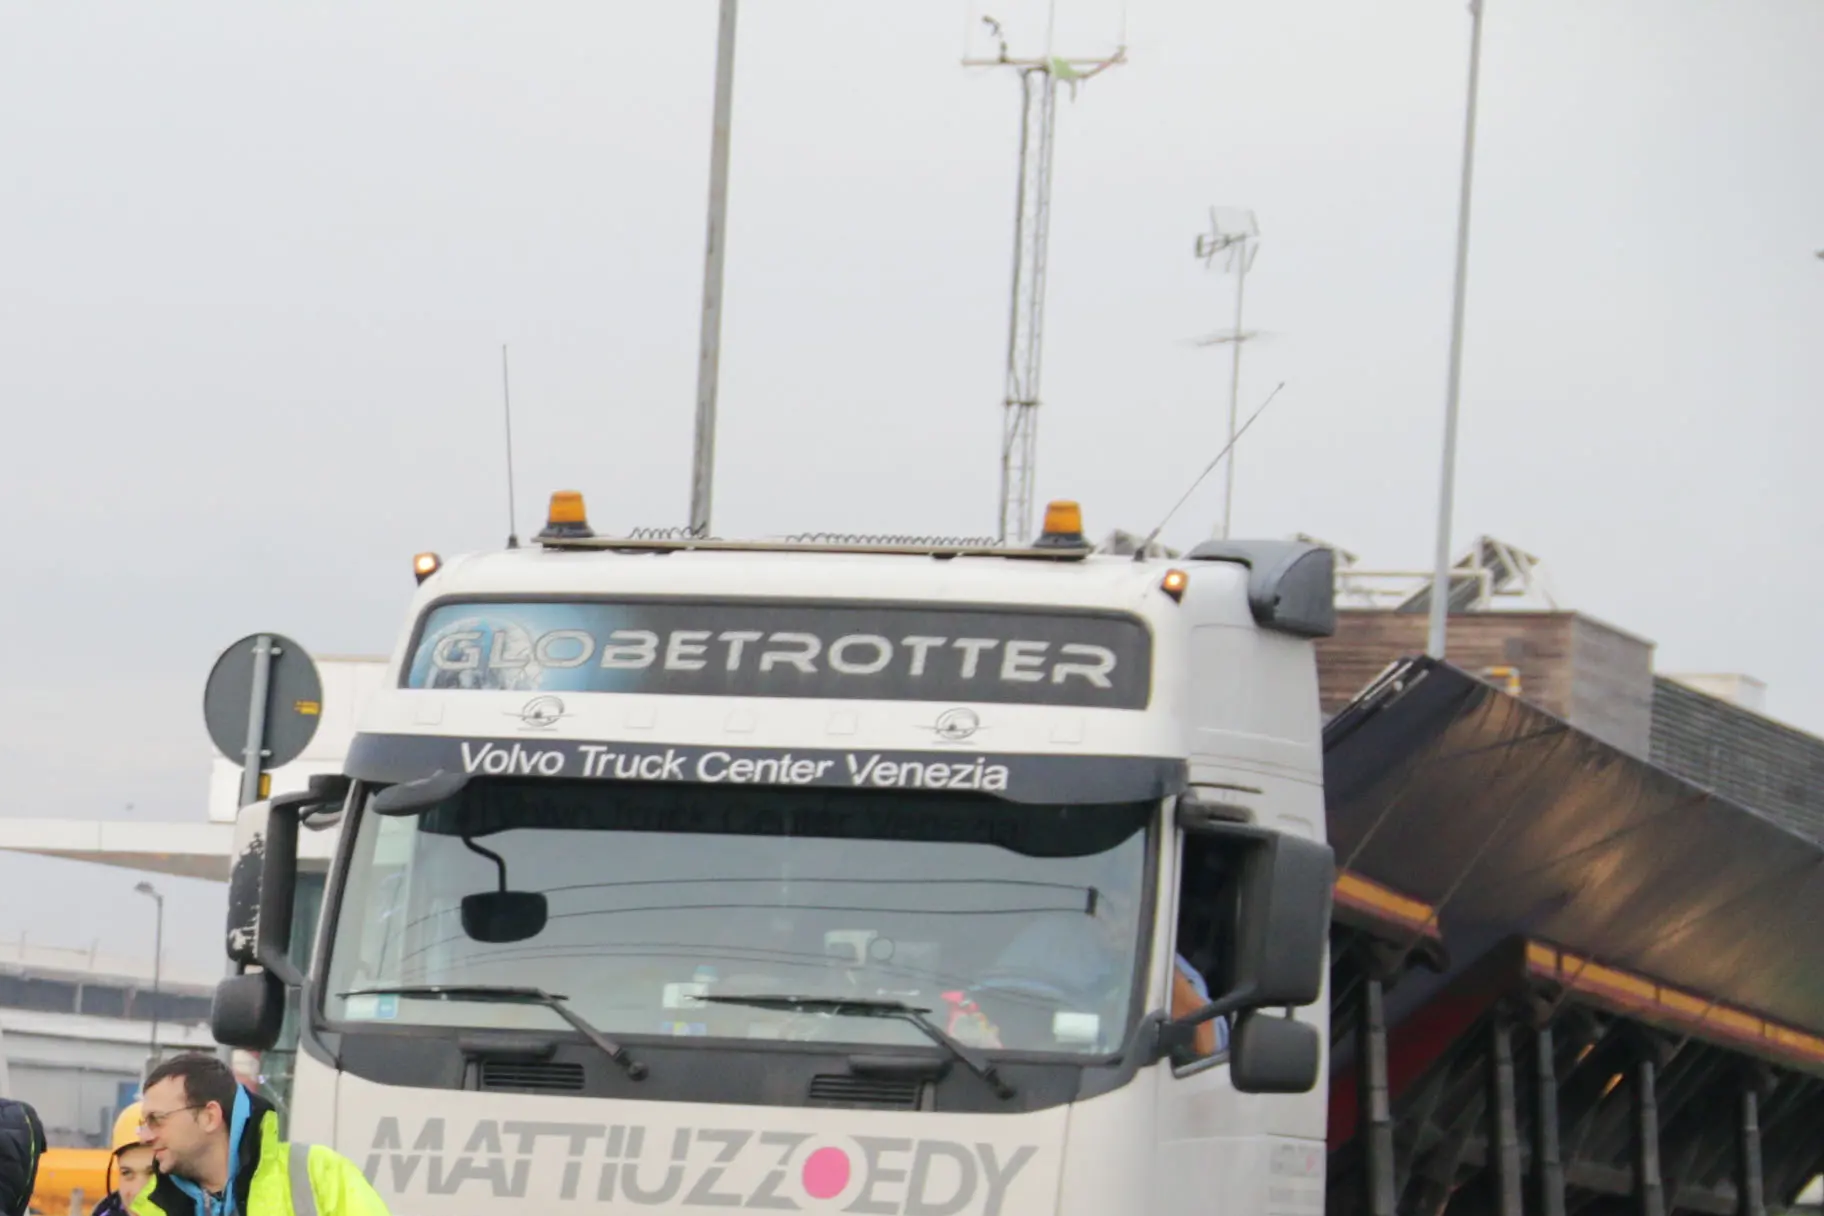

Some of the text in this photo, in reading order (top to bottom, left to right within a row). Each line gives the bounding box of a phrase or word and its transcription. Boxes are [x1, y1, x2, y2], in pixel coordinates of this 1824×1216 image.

[431, 628, 1118, 689] GLOBETROTTER
[459, 742, 1010, 791] Volvo Truck Center Venezia
